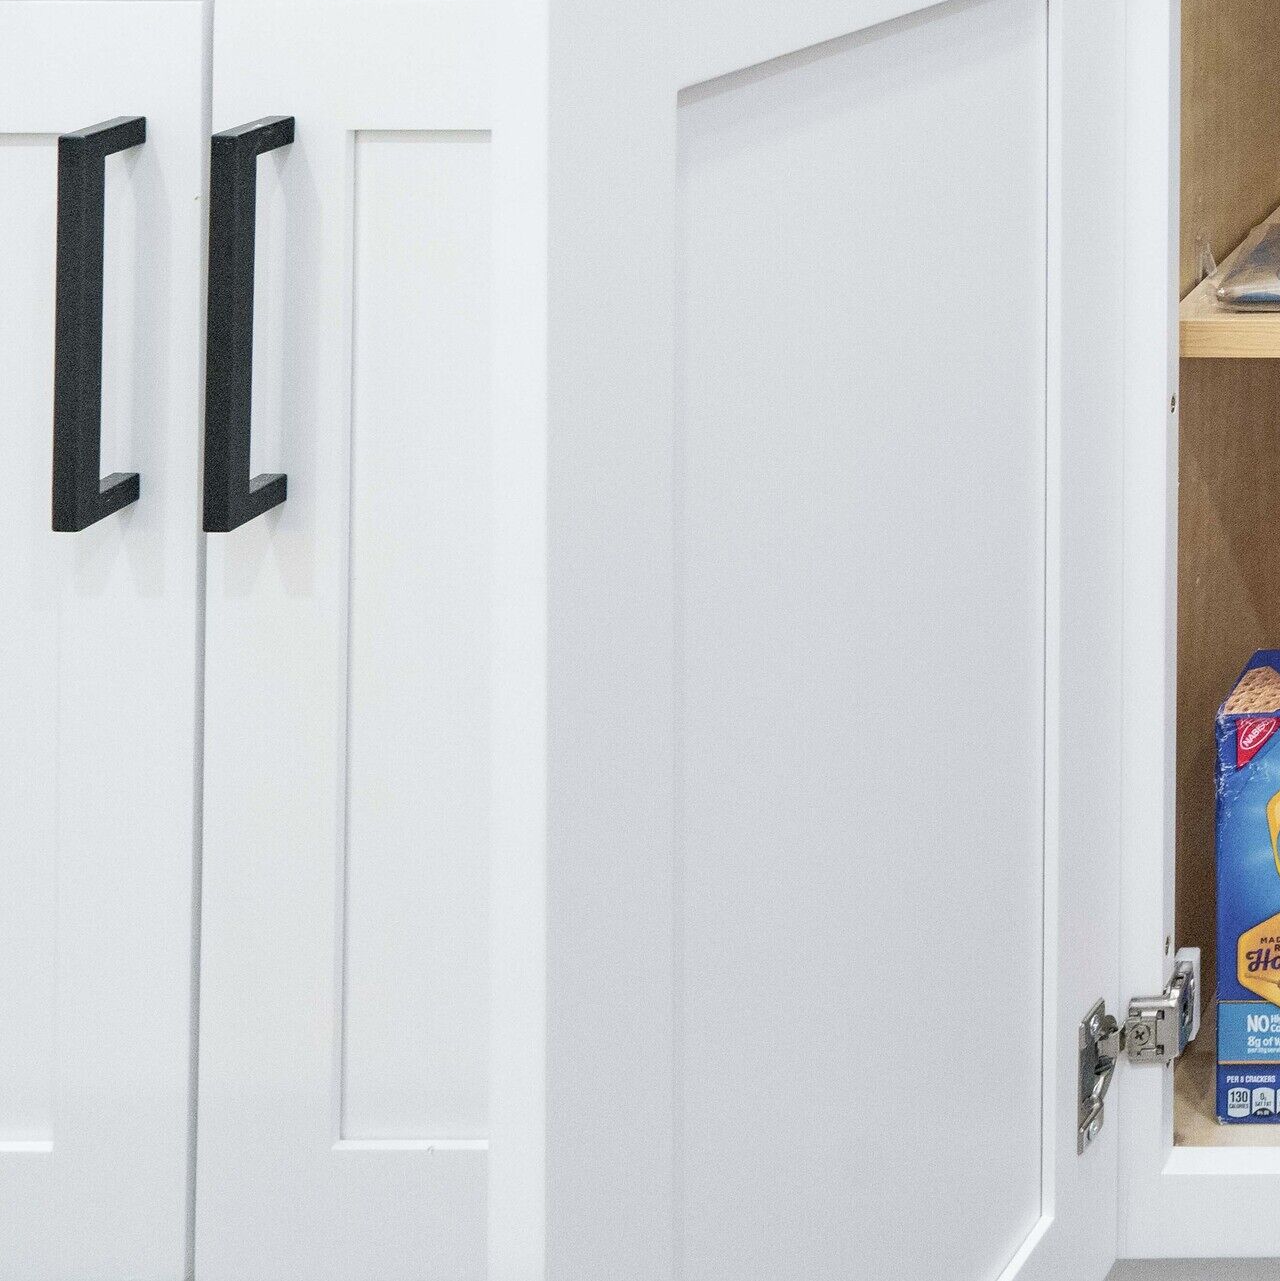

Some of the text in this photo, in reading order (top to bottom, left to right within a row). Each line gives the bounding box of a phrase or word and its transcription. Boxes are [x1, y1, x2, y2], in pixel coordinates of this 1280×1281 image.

[1247, 1014, 1270, 1033] NO
[1247, 1037, 1261, 1048] 8g
[1263, 1036, 1273, 1046] of
[1226, 1075, 1240, 1083] PER
[1245, 1075, 1276, 1083] CRACKERS
[1231, 1091, 1248, 1103] 130
